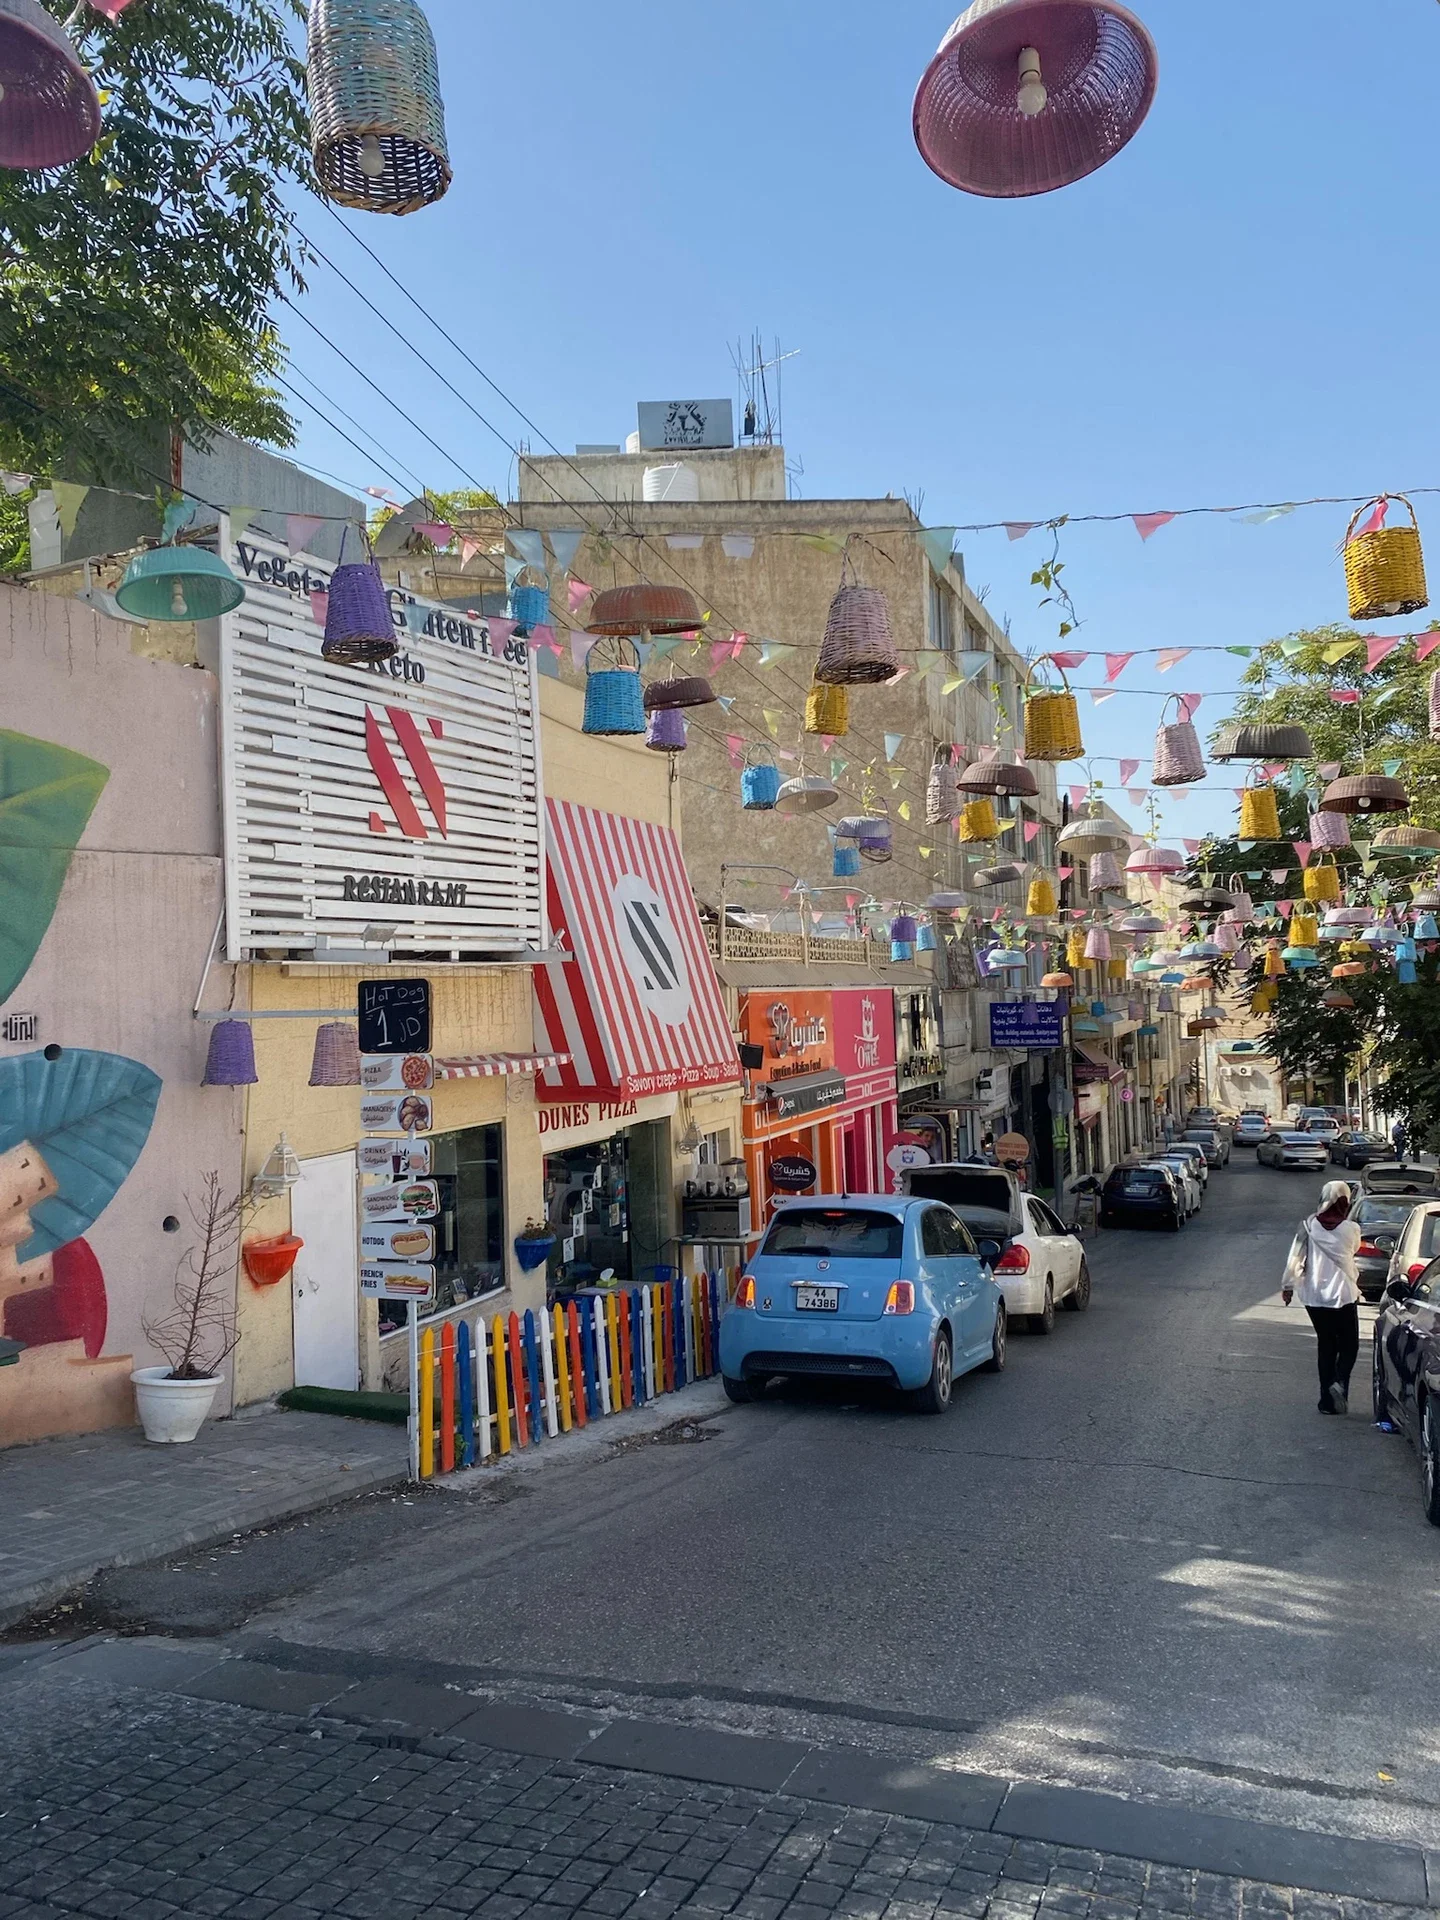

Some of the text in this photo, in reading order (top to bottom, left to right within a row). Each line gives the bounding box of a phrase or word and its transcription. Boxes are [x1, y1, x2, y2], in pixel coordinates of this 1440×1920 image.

[386, 589, 527, 666] Guten fee
[377, 1009, 393, 1047] 1
[627, 1061, 739, 1093] Savory crepe Pizza Soup Salad
[538, 1099, 637, 1134] DUNES PIZZA
[362, 1236, 385, 1246] HOTDOG
[360, 1269, 384, 1278] FRENCH
[360, 1280, 378, 1288] FRIES
[814, 1288, 827, 1298] 44
[804, 1299, 836, 1308] 74386
